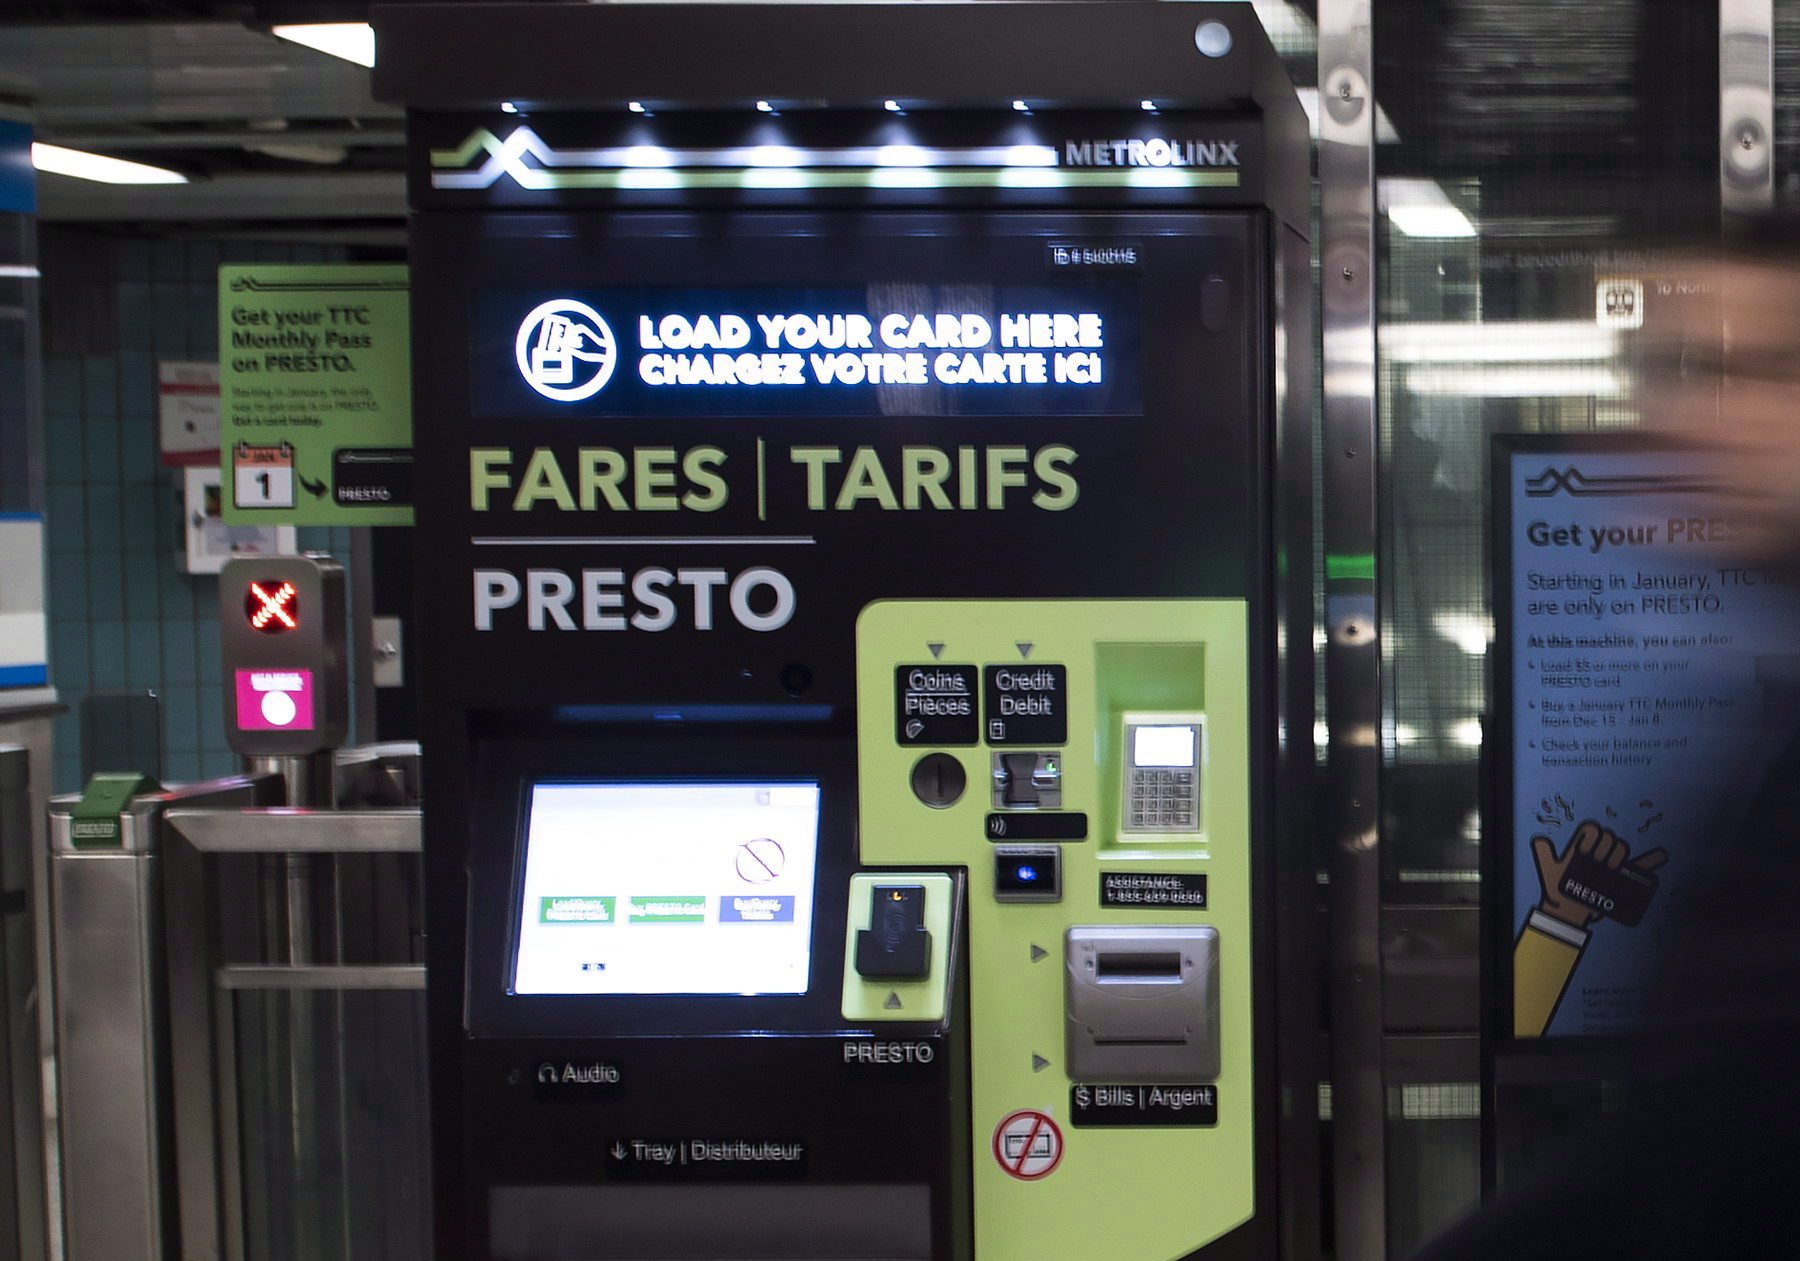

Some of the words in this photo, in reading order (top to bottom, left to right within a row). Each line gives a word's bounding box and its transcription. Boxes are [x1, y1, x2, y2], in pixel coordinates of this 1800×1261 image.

[1065, 138, 1240, 168] METROLINX
[231, 305, 269, 326] Get
[274, 308, 323, 332] your
[328, 306, 371, 326] TTC
[231, 331, 321, 354] Monthly
[325, 331, 373, 349] Pass
[639, 314, 751, 349] LOAD
[757, 314, 874, 349] YOUR
[879, 314, 992, 349] CARD
[1000, 314, 1104, 349] HERE
[231, 357, 260, 373] on
[265, 353, 357, 374] PRESTO.
[638, 352, 806, 385] CHARGEZ
[810, 352, 929, 385] VOTRE
[933, 352, 1047, 385] CARTE
[1054, 352, 1102, 385] ICI
[255, 471, 270, 501] 1
[470, 445, 730, 512] FARES
[790, 444, 1081, 512] TARIFS
[1526, 520, 1582, 547] Get
[1590, 522, 1658, 553] your
[1527, 571, 1602, 595] Starting
[1608, 572, 1627, 591] in
[1633, 570, 1712, 593] January,
[1717, 568, 1757, 588] TTC
[472, 567, 797, 632] PRESTO
[1527, 600, 1560, 616] are
[1563, 595, 1606, 620] only
[1611, 599, 1636, 615] on
[1641, 594, 1725, 616] PRESTO.
[1547, 633, 1574, 648] this
[1643, 637, 1668, 651] you
[1672, 636, 1696, 648] can
[909, 669, 967, 691] Coins
[995, 669, 1056, 691] Credit
[1541, 676, 1591, 689] PRESTO
[1594, 675, 1621, 688] card
[1000, 693, 1053, 716] Debit
[1541, 700, 1565, 714] Buy
[1656, 697, 1706, 712] Monthly
[1542, 737, 1580, 751] Check
[1583, 739, 1610, 752] your
[1613, 736, 1661, 750] balance
[1542, 753, 1609, 767] transaction
[1612, 752, 1651, 767] history
[1565, 878, 1615, 911] PRESTO
[844, 1041, 934, 1063] PRESTO
[562, 1061, 619, 1083] Audio
[1095, 1086, 1135, 1107] Bills
[1150, 1086, 1214, 1110] Argent
[632, 1139, 676, 1165] Tray
[691, 1138, 803, 1161] Distributeur
